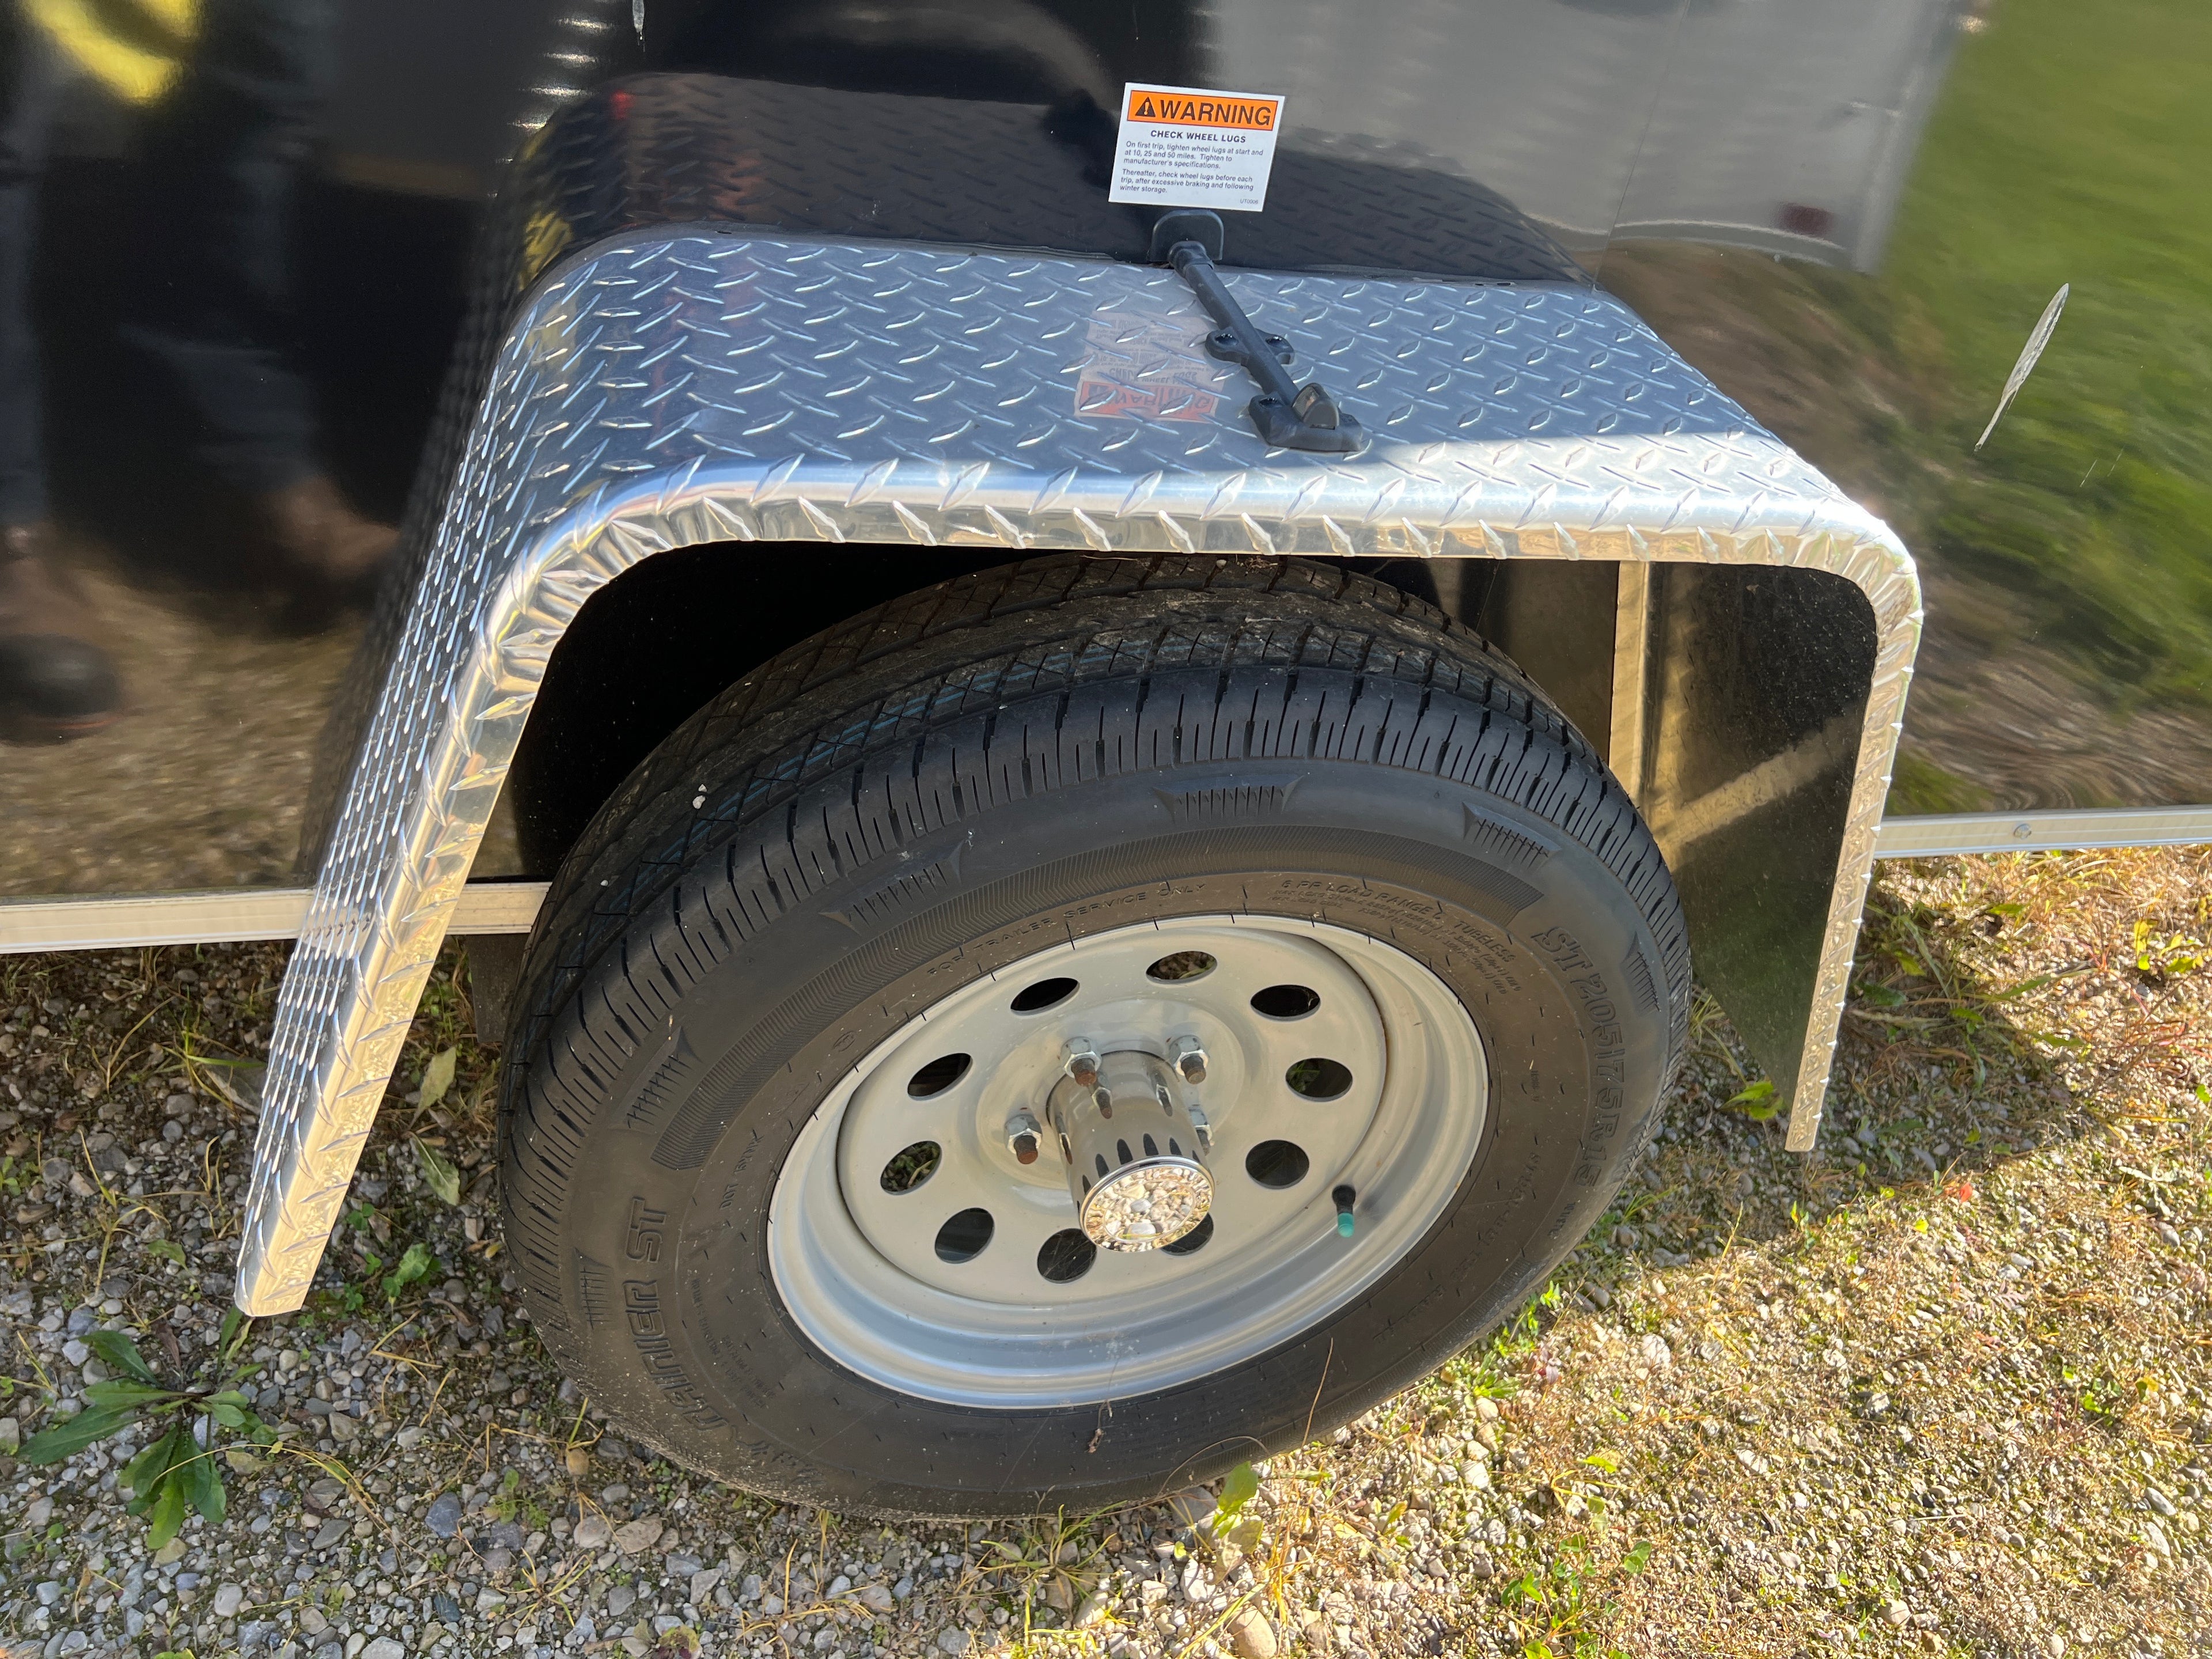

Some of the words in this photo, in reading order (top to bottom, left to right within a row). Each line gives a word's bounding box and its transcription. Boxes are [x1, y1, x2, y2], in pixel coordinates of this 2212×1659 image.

[1160, 99, 1271, 126] WARNING
[1150, 130, 1183, 139] CHECK
[1187, 132, 1218, 141] WHEEL
[1221, 135, 1246, 143] LUGS
[1167, 143, 1190, 151] tighten
[1212, 146, 1225, 154] lugs
[1123, 158, 1172, 166] manufacturer's
[1174, 161, 1221, 169] specifications.
[1200, 154, 1224, 162] Tighten
[1122, 168, 1157, 177] Thereafter,
[1185, 180, 1210, 189] braking
[1225, 183, 1253, 192] following
[926, 954, 966, 975] FOR
[974, 917, 1059, 950] TRAILER
[1064, 891, 1147, 919] SERVICE
[1158, 882, 1207, 897] ONLY
[1326, 884, 1373, 897] LOAD
[1375, 893, 1433, 915] RANGE
[1454, 921, 1516, 963] TUBELESS
[1531, 925, 1594, 972] ST
[719, 1183, 739, 1209] DOT
[625, 1195, 667, 1263] ST
[622, 1279, 728, 1431] RAINIER
